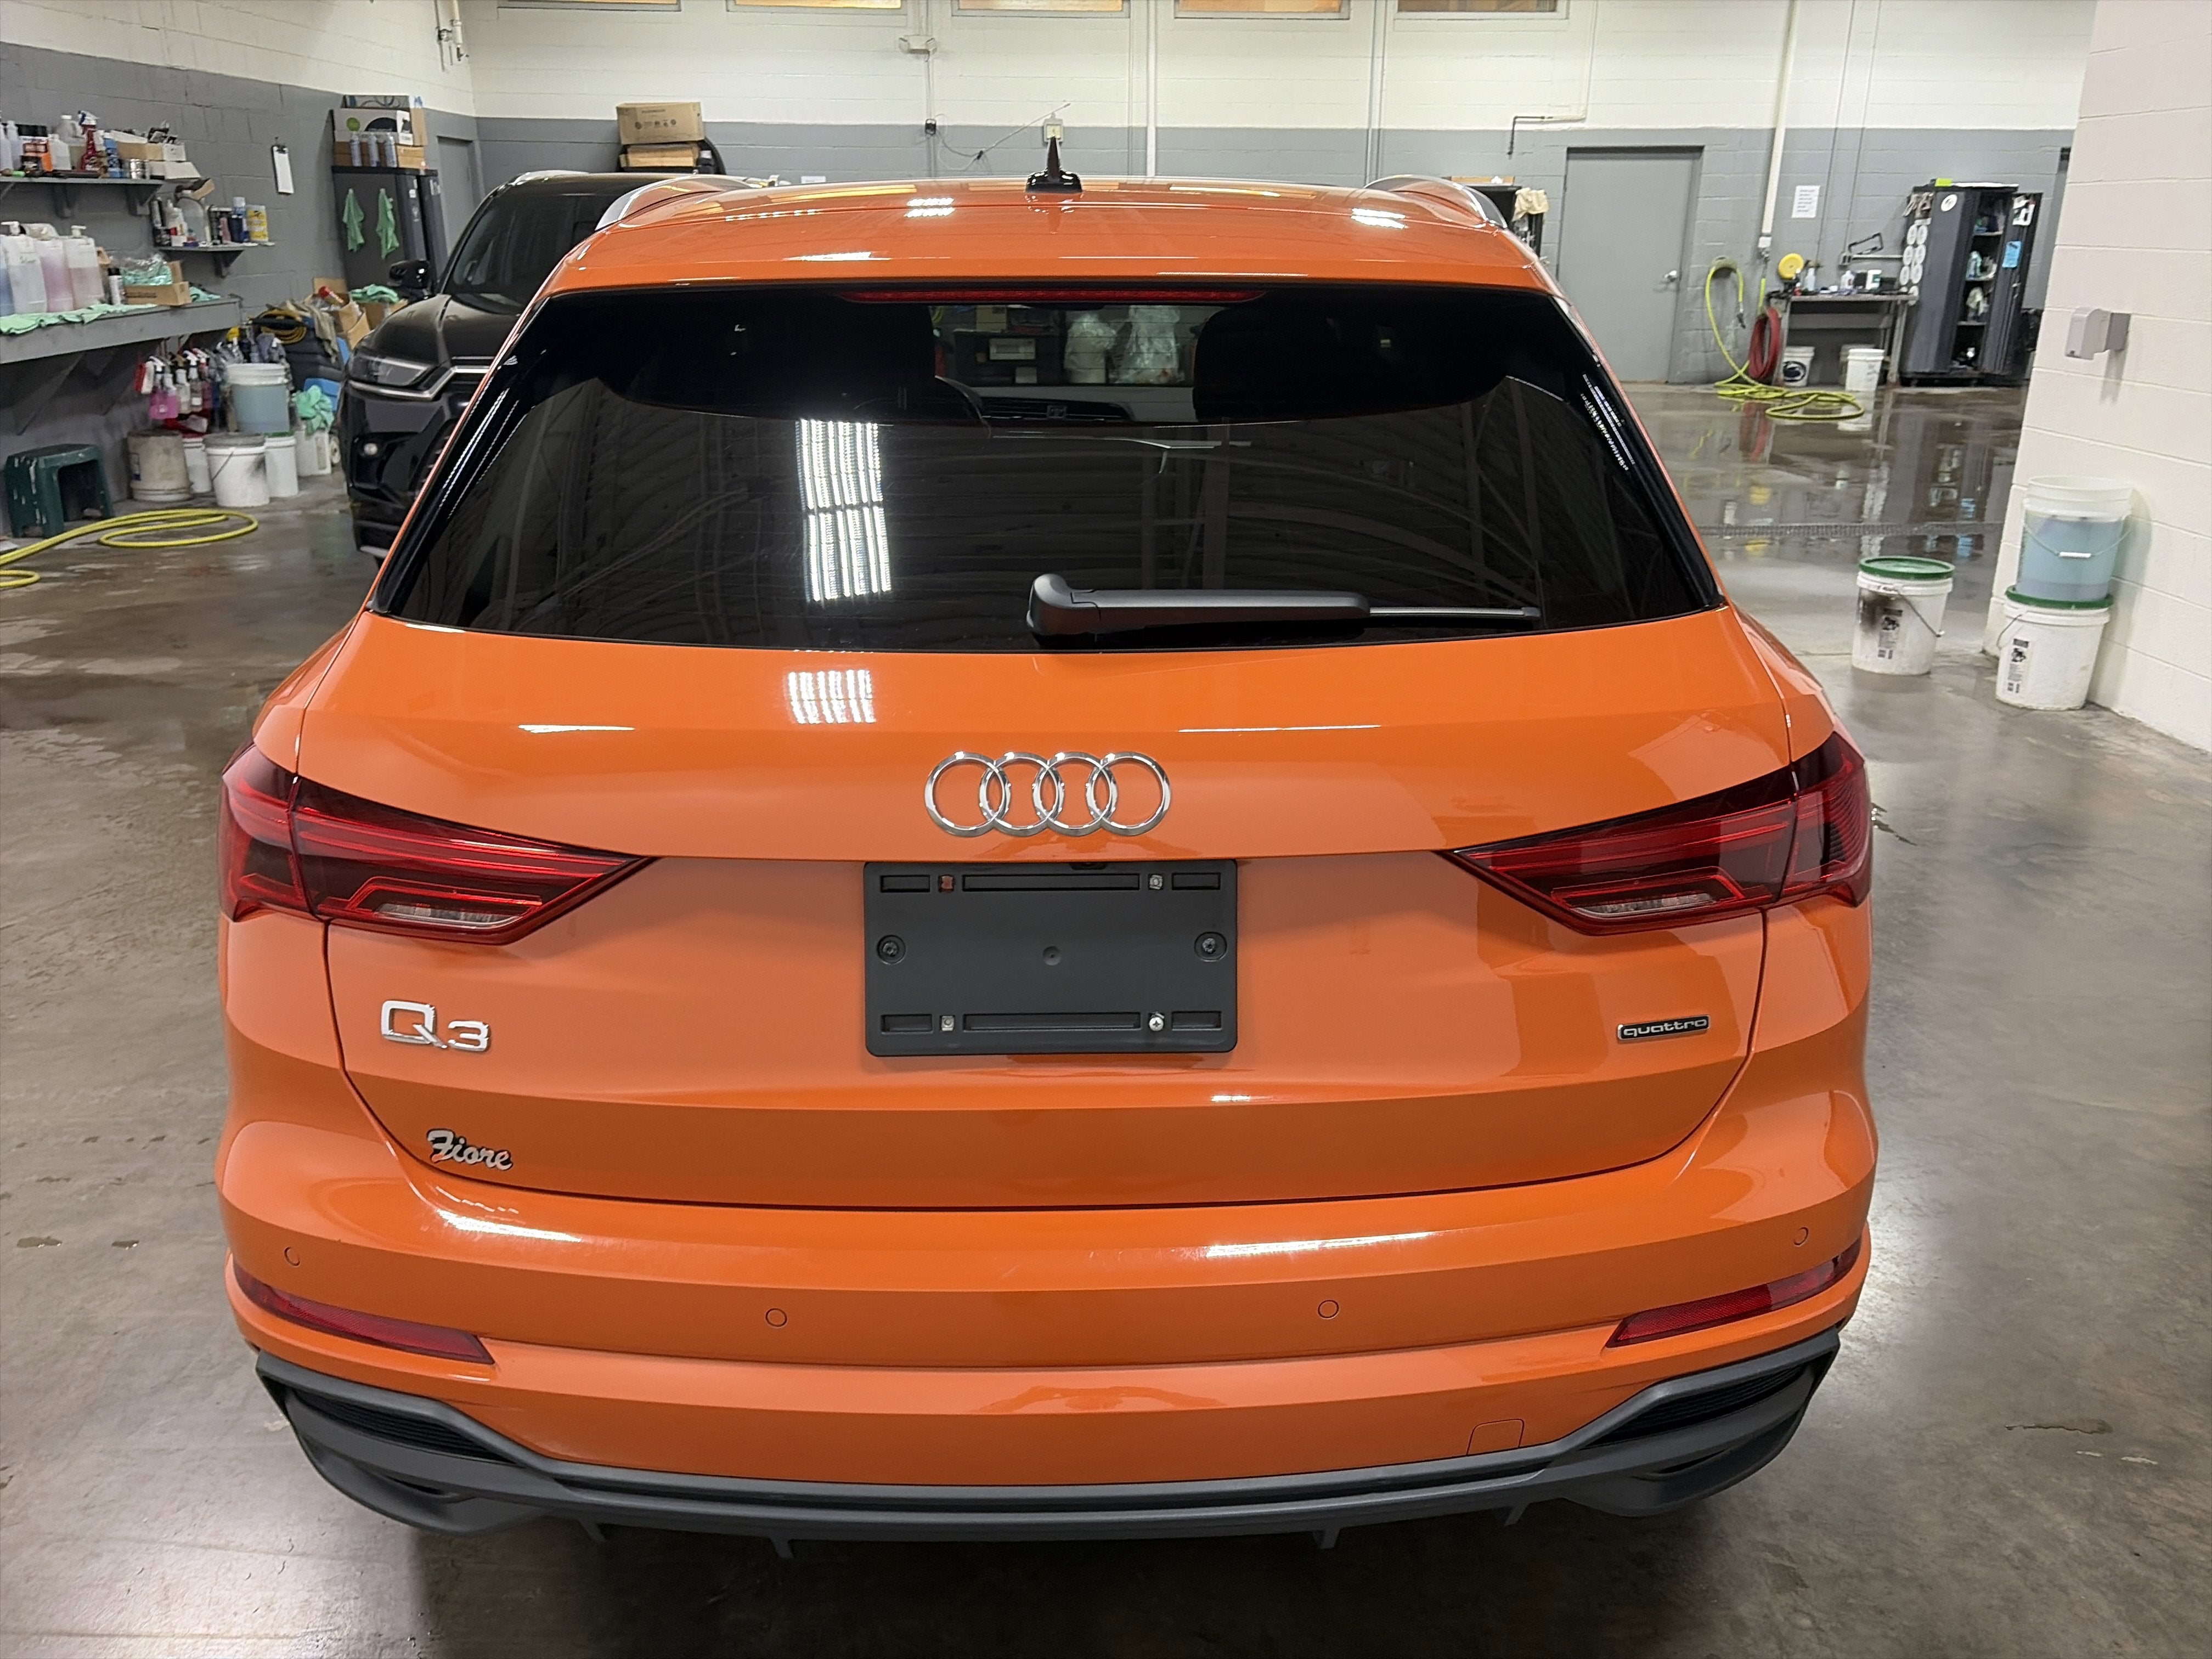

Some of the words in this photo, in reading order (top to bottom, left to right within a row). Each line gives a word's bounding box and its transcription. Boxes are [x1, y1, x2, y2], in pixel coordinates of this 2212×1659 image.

[381, 1000, 489, 1052] Q3
[1623, 1019, 1707, 1037] quattro
[427, 1129, 513, 1171] Fiore
